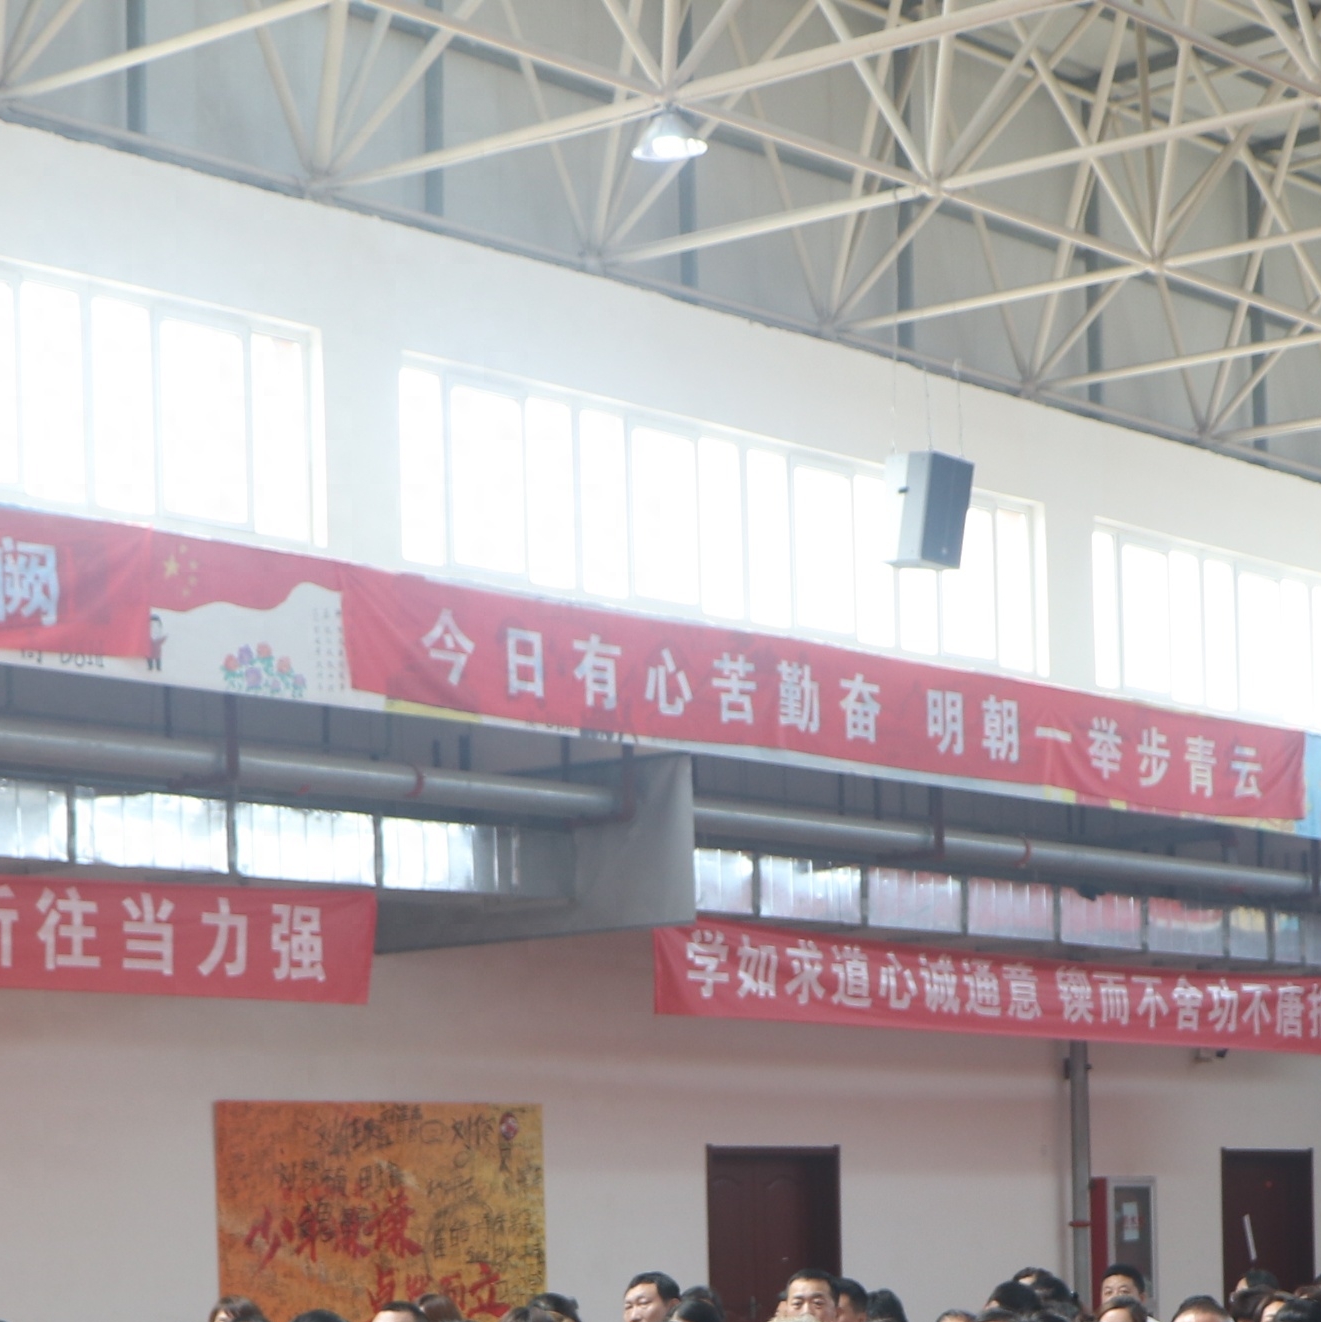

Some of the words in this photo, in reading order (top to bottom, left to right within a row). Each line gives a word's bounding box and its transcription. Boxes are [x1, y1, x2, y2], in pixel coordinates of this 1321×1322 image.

[421, 608, 879, 744] 今日有心苦勤奋
[926, 688, 1264, 799] 明朝一举步青云
[686, 929, 1042, 1020] 学如求道心诚通意
